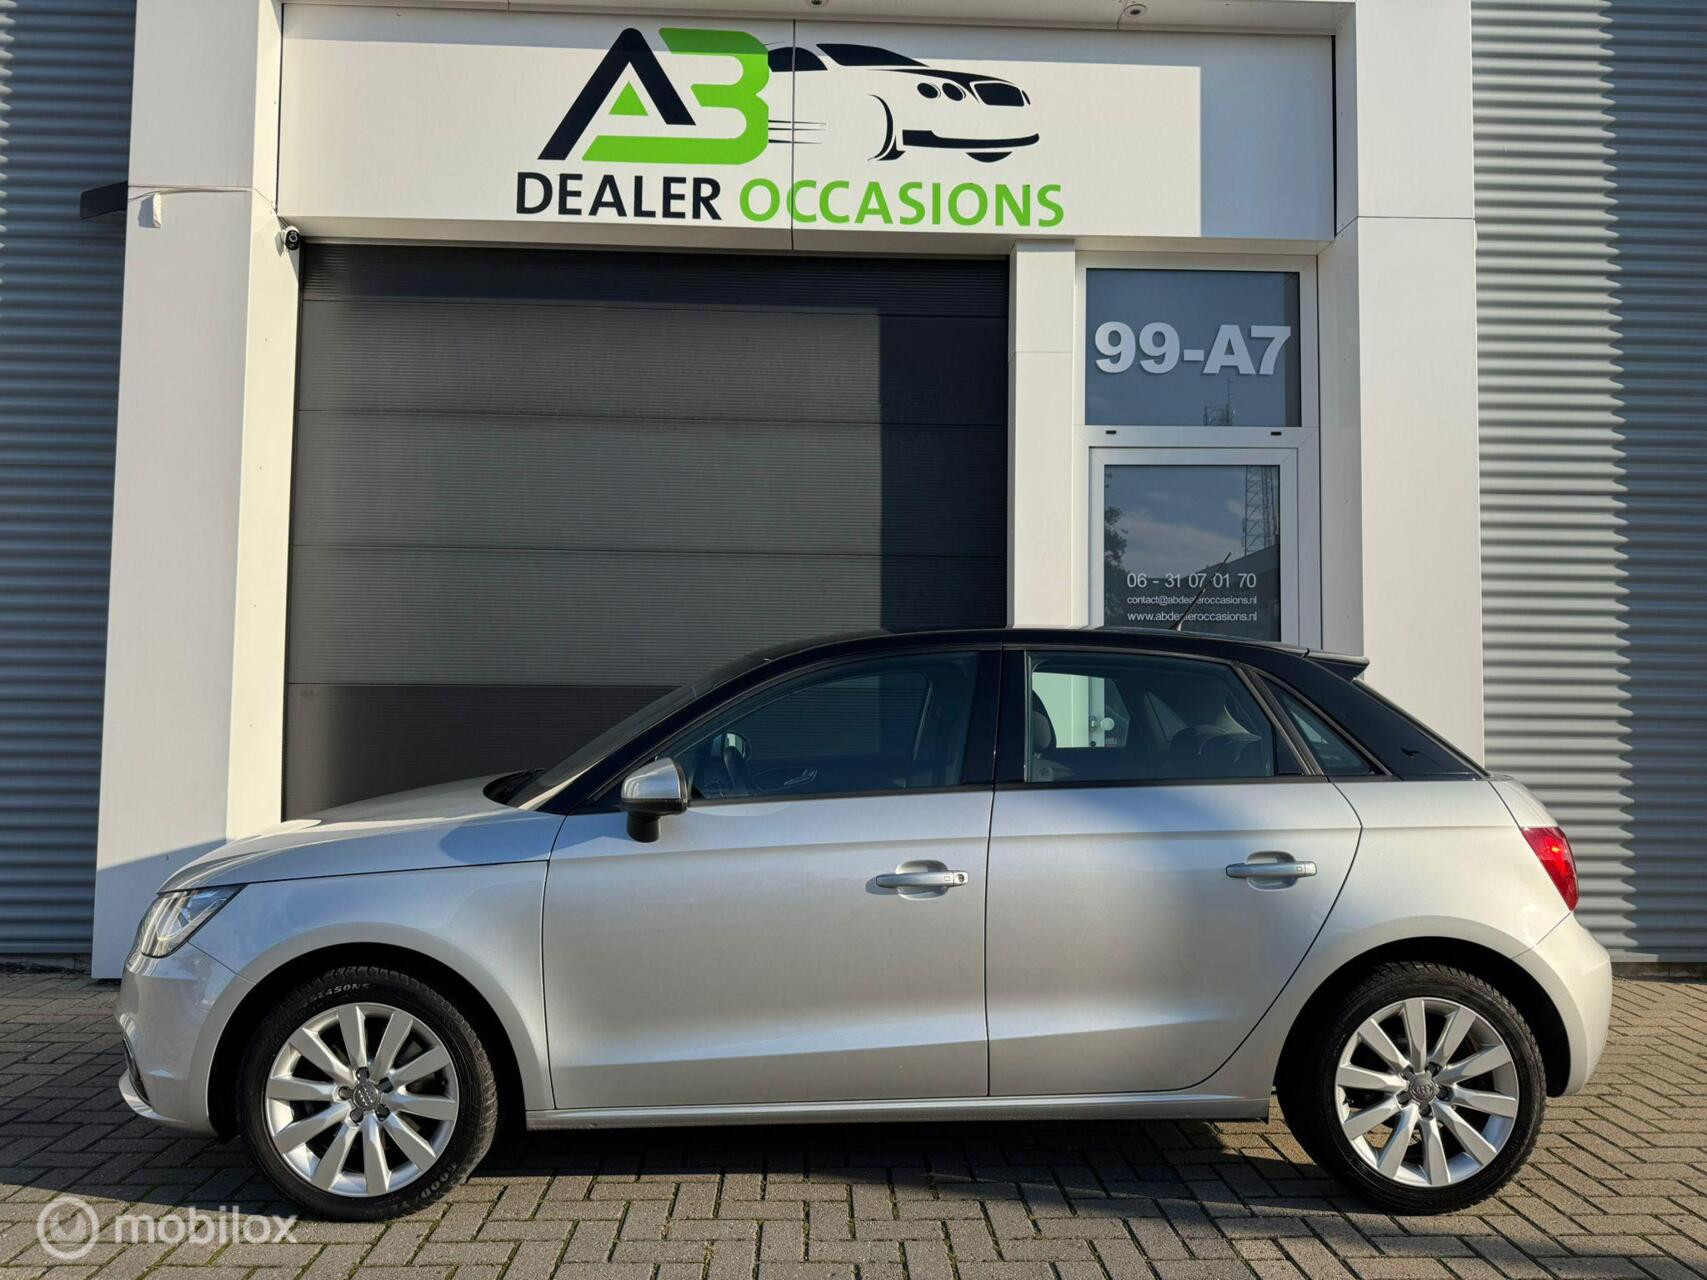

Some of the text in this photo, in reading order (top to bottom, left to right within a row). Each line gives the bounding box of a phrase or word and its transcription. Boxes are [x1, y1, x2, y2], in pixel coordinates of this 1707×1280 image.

[516, 171, 1065, 228] DEALER OCCASIONS
[1094, 321, 1292, 375] 99-A7
[1126, 572, 1147, 588] 06
[1164, 572, 1181, 588] 31
[1188, 572, 1207, 588] 07
[1212, 573, 1230, 588] 01
[1238, 573, 1257, 588] 70
